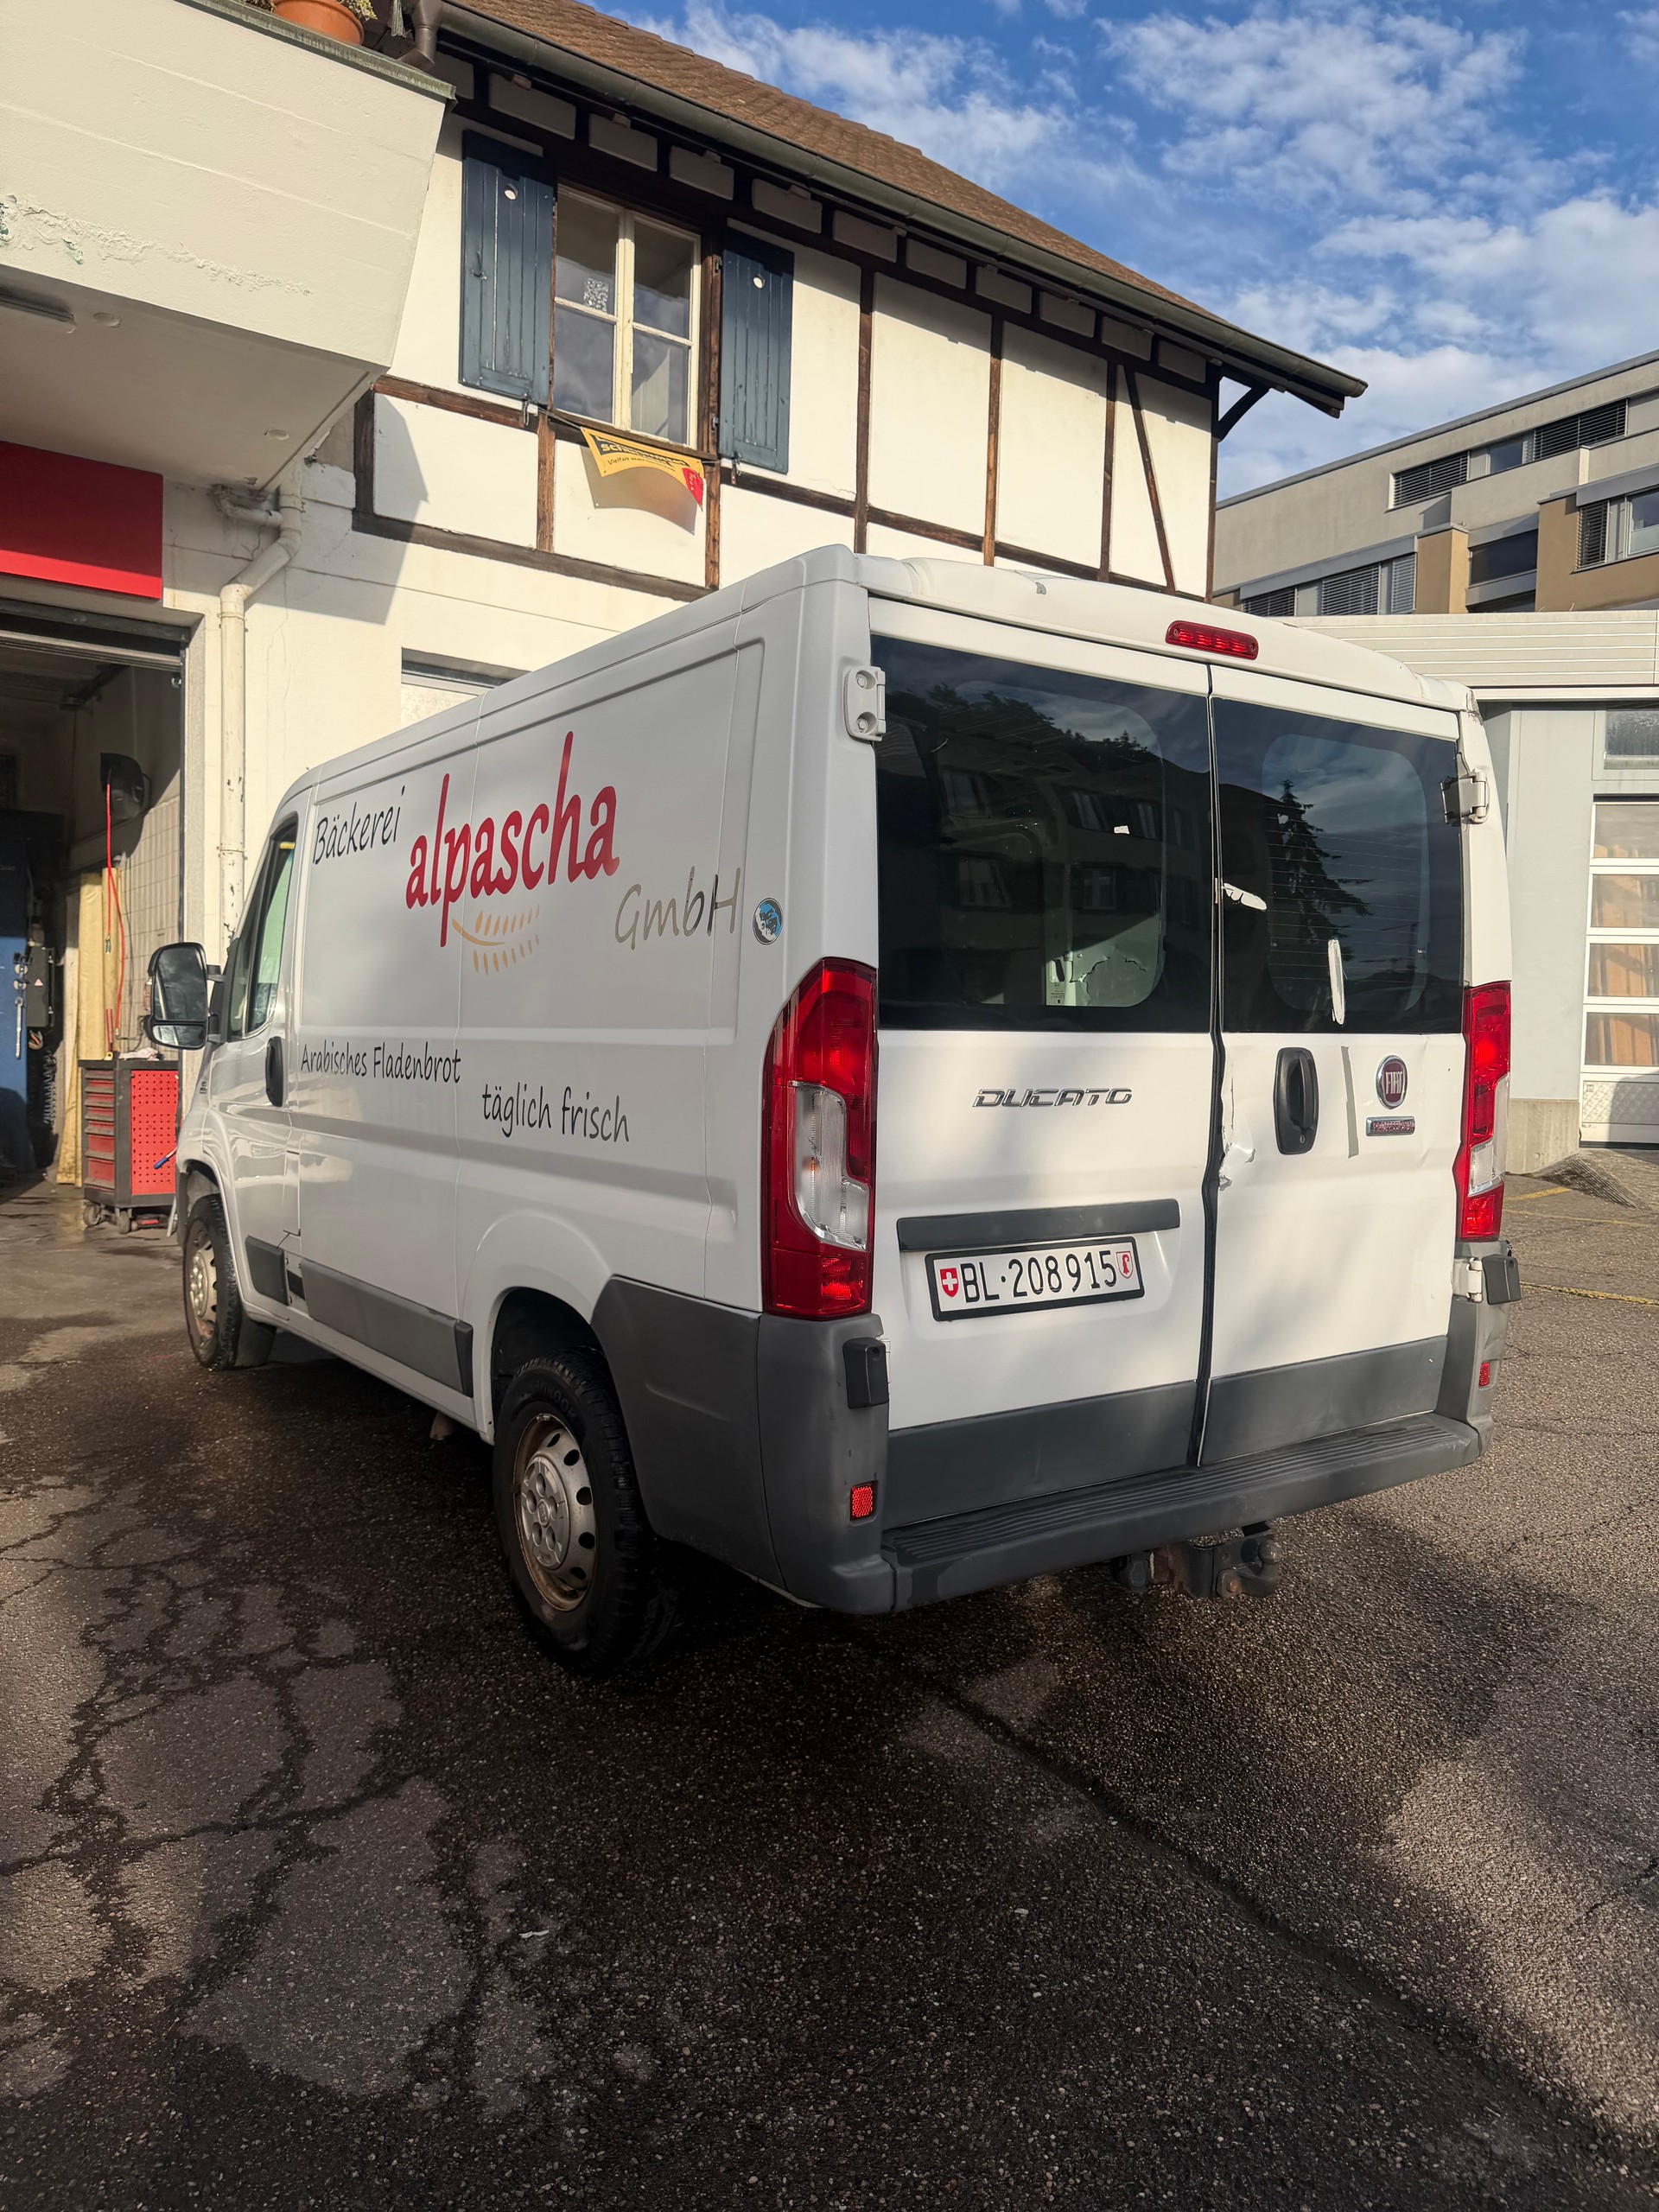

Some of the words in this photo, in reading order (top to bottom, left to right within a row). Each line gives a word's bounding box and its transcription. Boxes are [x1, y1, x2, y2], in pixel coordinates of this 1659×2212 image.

[313, 785, 405, 864] Bäckerei
[405, 731, 620, 947] alpascha
[614, 866, 741, 950] GmbH
[300, 1043, 367, 1077] Arabisches
[372, 1042, 461, 1083] Fladenbrot
[1385, 1071, 1402, 1095] FIAT
[482, 1082, 551, 1137] täglich
[562, 1086, 629, 1142] frisch
[972, 1088, 1133, 1108] DUCATO
